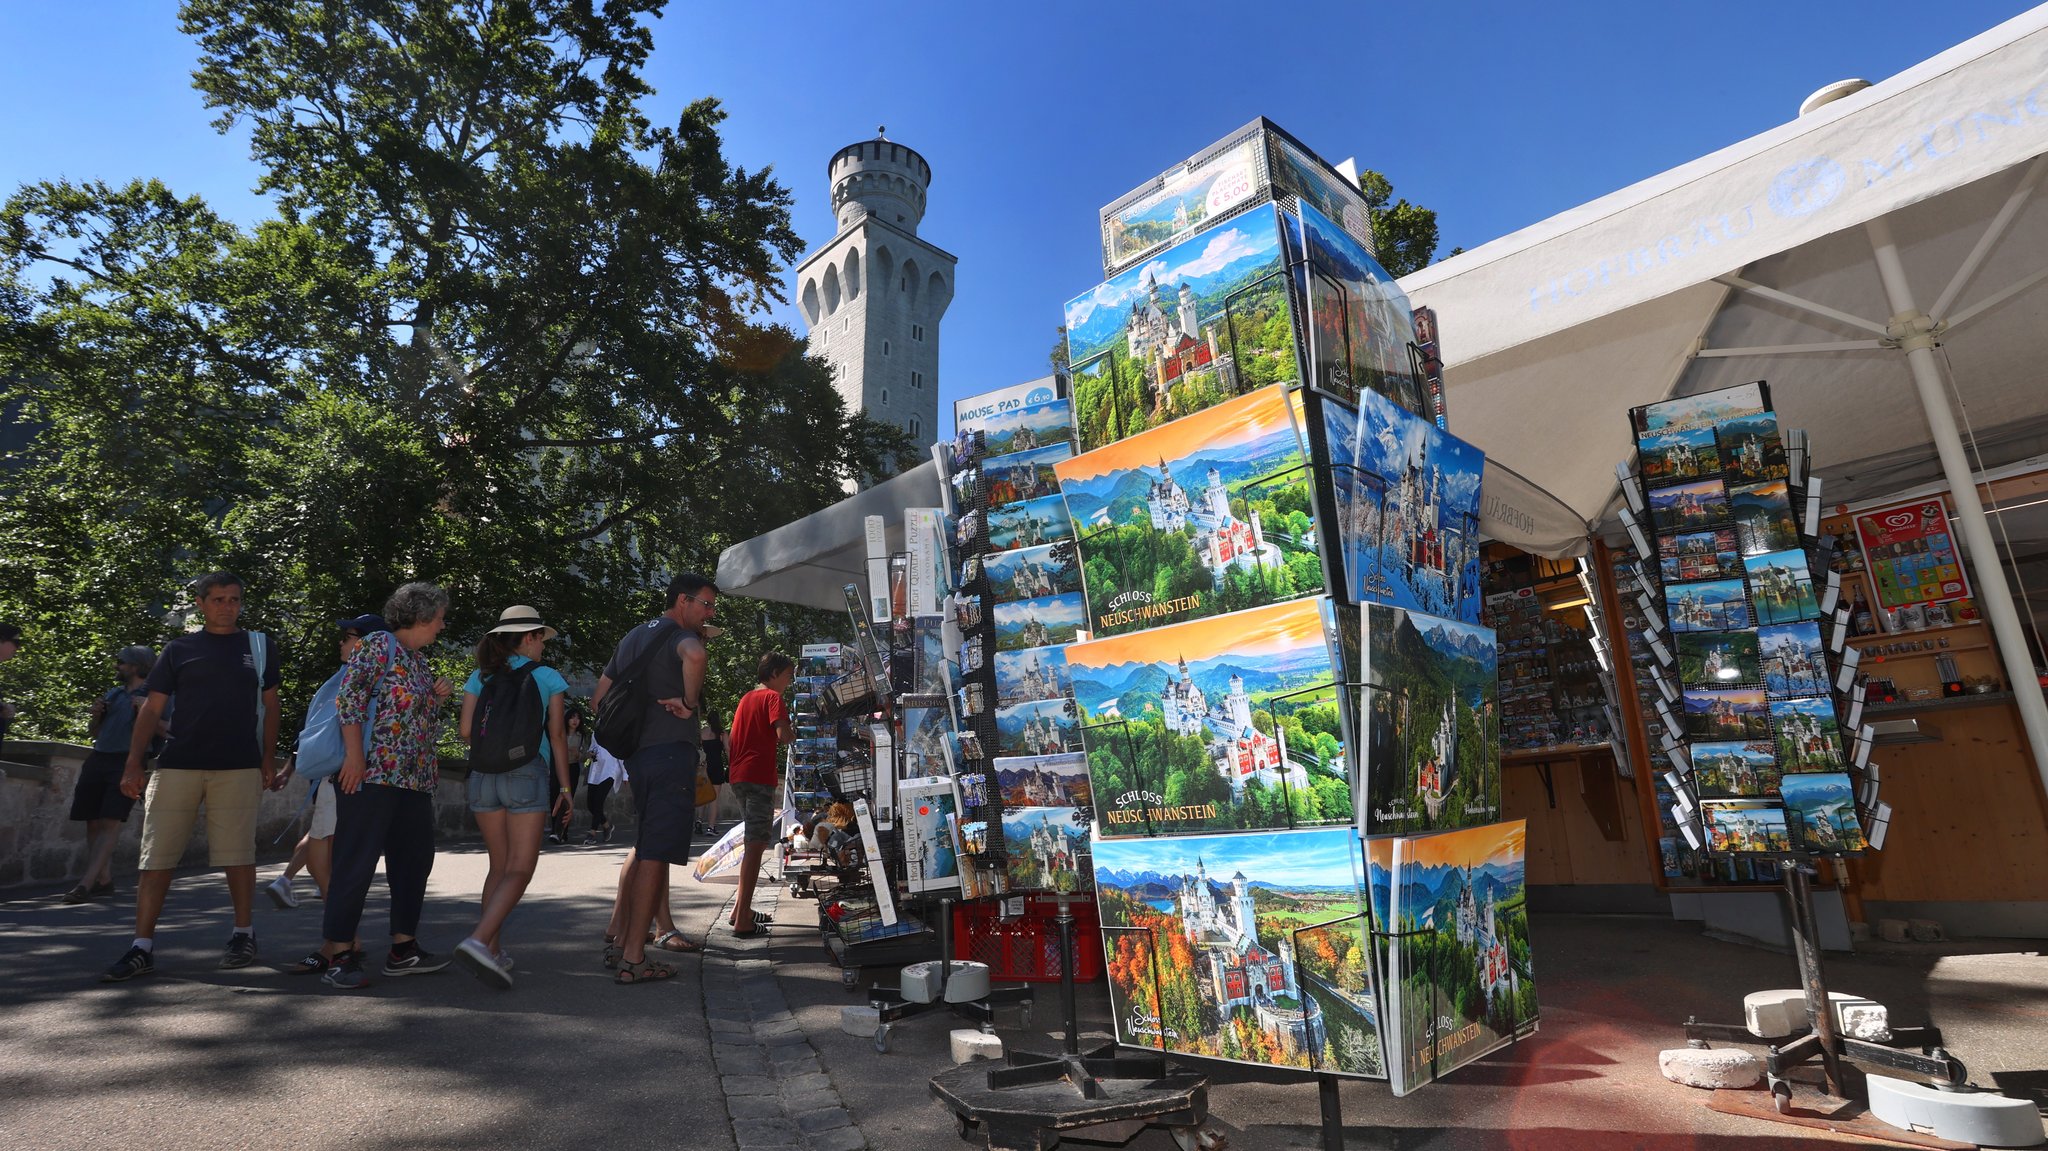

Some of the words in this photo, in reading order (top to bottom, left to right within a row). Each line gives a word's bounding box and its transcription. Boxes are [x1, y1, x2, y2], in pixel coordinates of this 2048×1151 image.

[1213, 196, 1221, 206] €
[1223, 182, 1249, 202] 5,00
[960, 404, 994, 422] MOUSE
[998, 398, 1020, 412] PAD
[910, 511, 918, 544] PUZZLE
[911, 548, 919, 585] QUALITY
[911, 589, 919, 612] HIGH
[1100, 594, 1200, 628] NEUSCHWANSTEIN
[906, 798, 914, 826] PUZZLE
[1115, 790, 1163, 809] SCHLOSS
[908, 828, 918, 860] QUALITY
[1425, 1015, 1454, 1043] SCLOSS
[1420, 1021, 1481, 1067] NEUCHWANSTEIN
